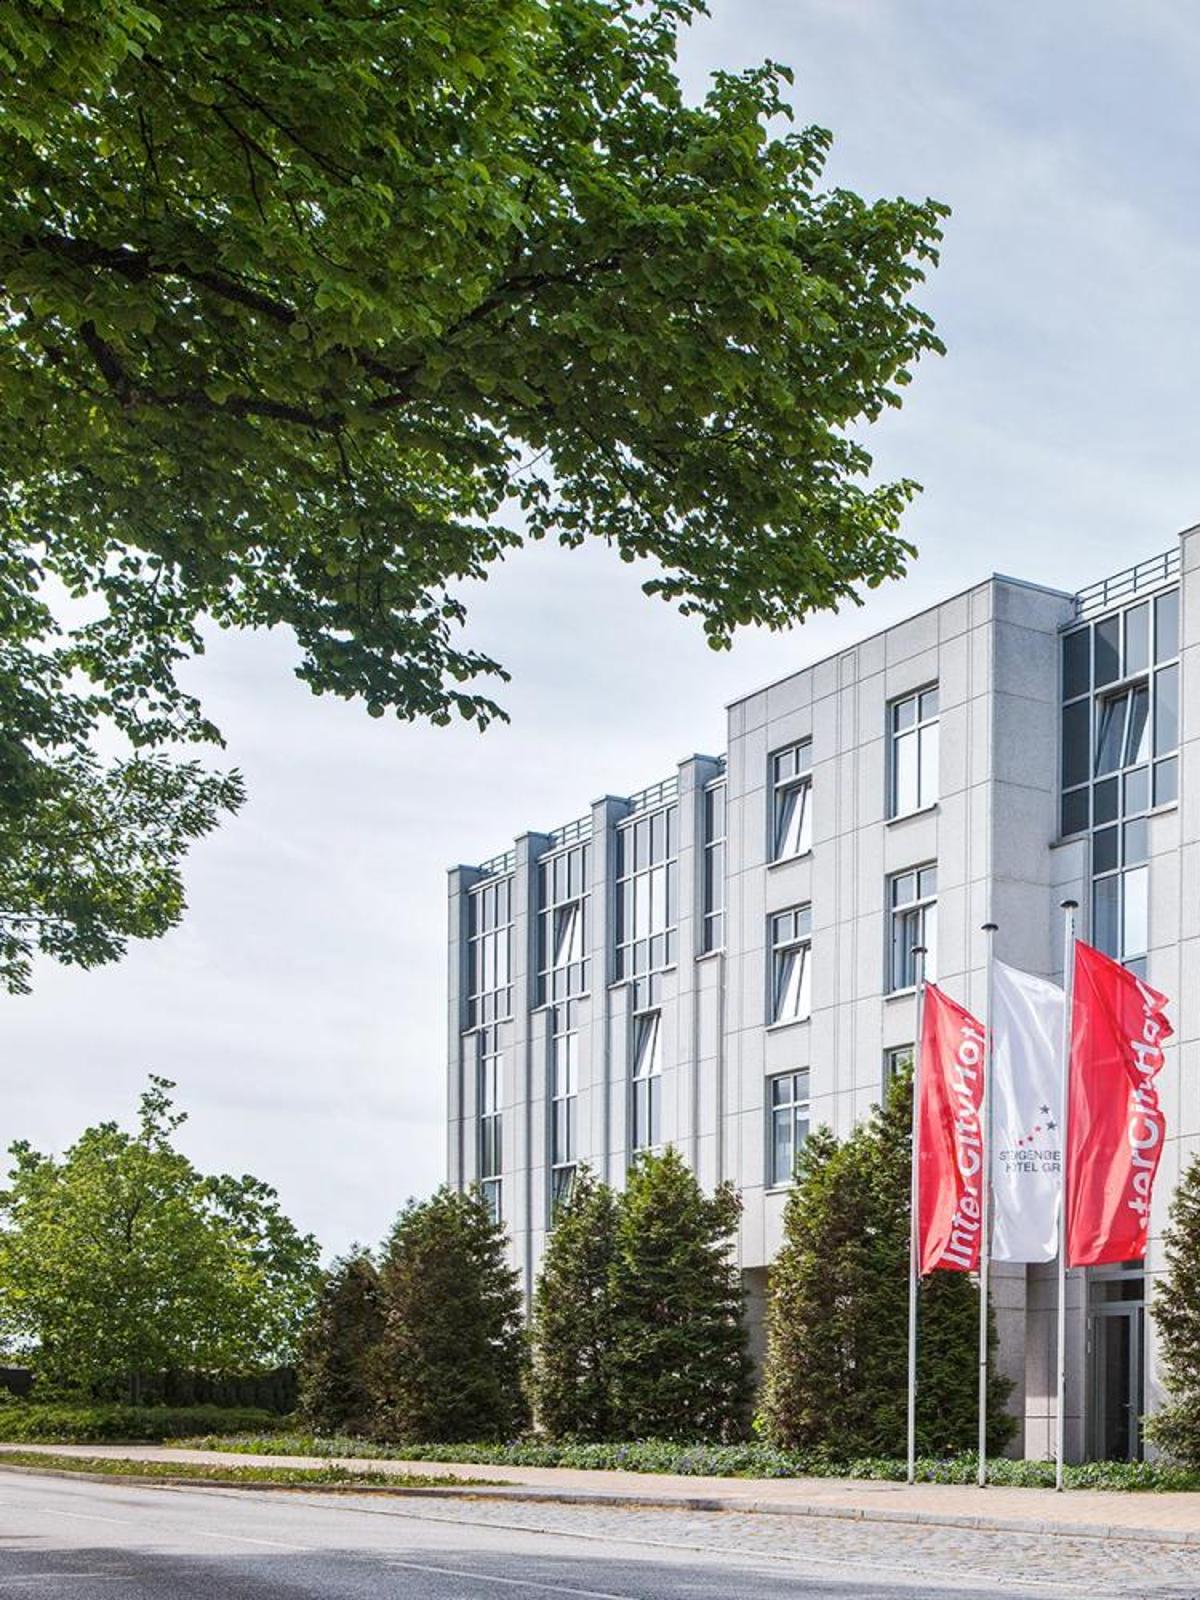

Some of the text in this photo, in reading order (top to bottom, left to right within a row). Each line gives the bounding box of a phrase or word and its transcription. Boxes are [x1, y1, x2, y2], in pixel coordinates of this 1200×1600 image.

[941, 1017, 985, 1268] InterCityHot
[998, 1149, 1061, 1161] SIGENBE
[1005, 1161, 1039, 1173] HTEL
